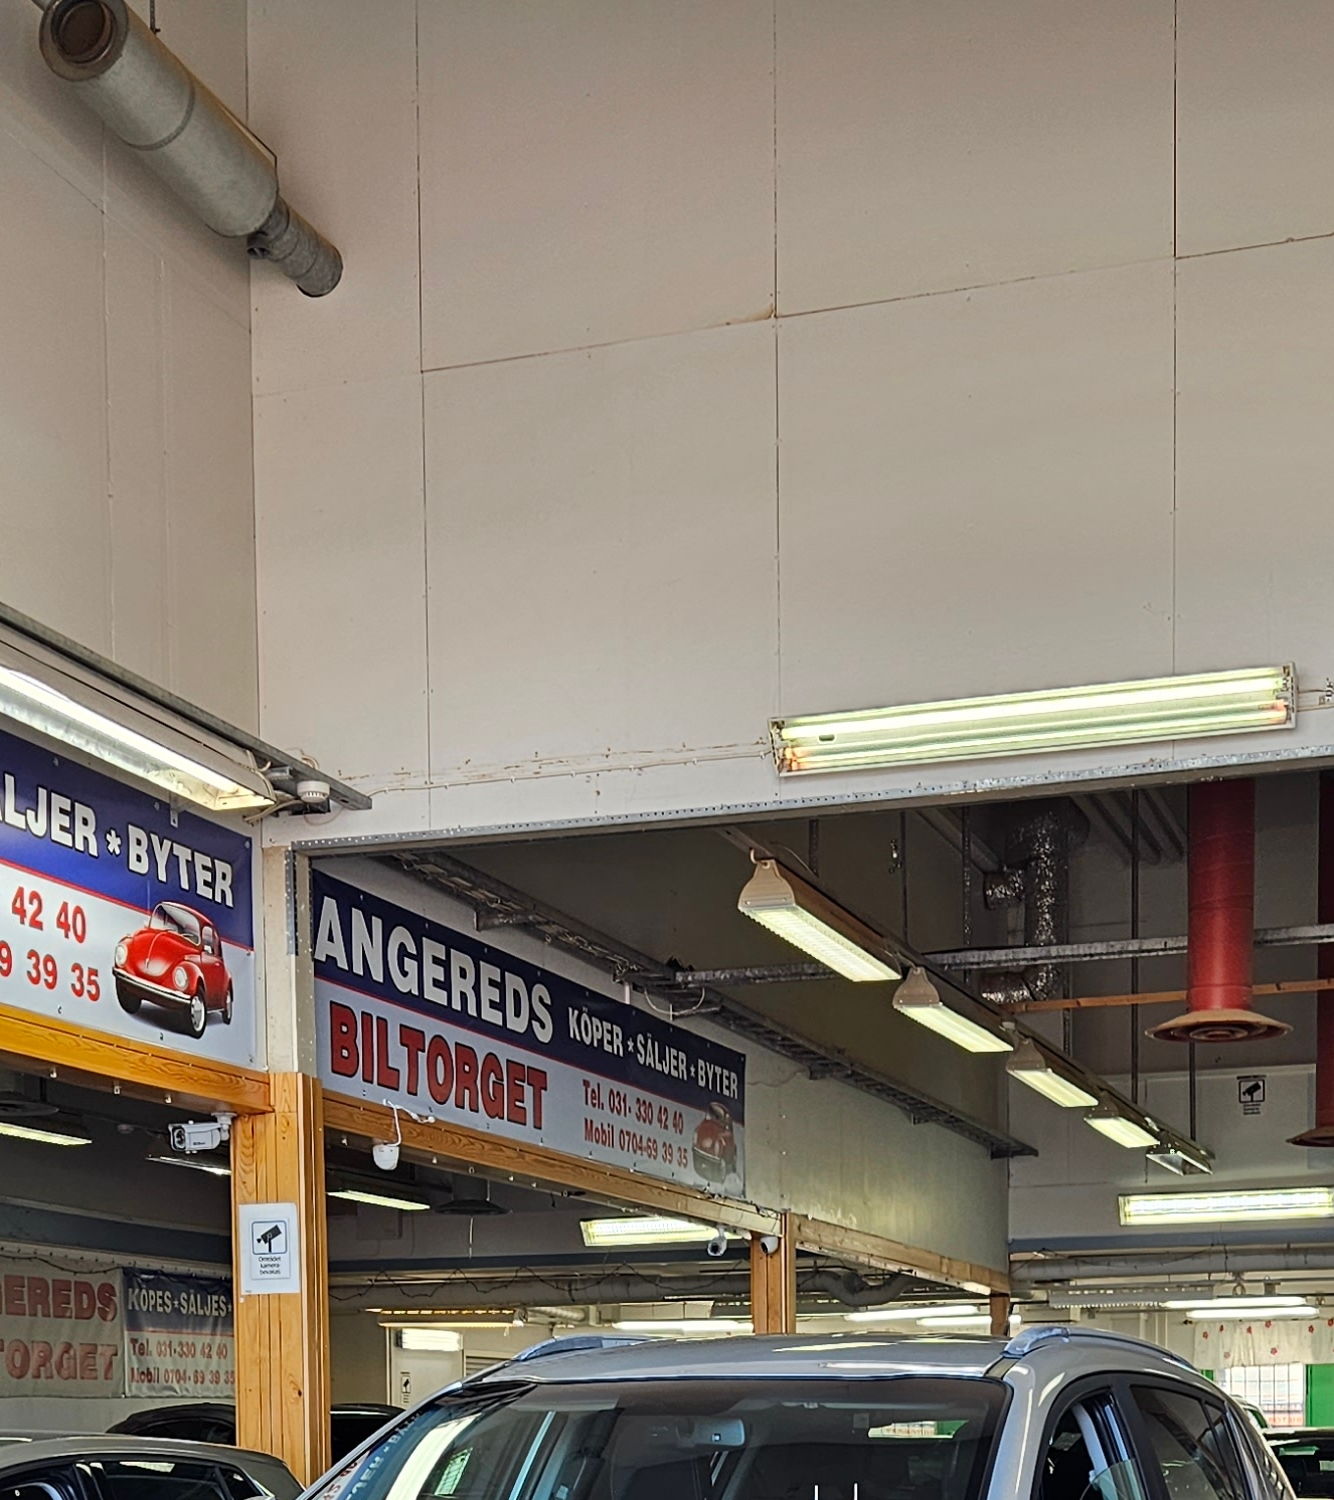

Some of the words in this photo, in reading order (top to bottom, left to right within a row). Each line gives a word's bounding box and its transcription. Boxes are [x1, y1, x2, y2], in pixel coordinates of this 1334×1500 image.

[127, 824, 234, 908] BYTER
[11, 886, 44, 931] 42
[56, 901, 86, 943] 40
[26, 949, 57, 990] 39
[70, 962, 100, 1001] 35
[314, 895, 554, 1044] ANGEREDS
[330, 1000, 548, 1130] BILTORGET
[568, 1006, 624, 1058] KÖPER
[637, 1031, 688, 1081] SÄLJER
[697, 1058, 738, 1100] BYTER
[582, 1079, 605, 1111] Tel.
[635, 1097, 654, 1125] 330
[657, 1105, 669, 1131] 42
[672, 1111, 684, 1136] 40
[584, 1117, 615, 1149] Mobil
[619, 1129, 657, 1161] 0704-69
[662, 1140, 674, 1165] 39
[677, 1146, 688, 1169] 35
[128, 1283, 172, 1314] KÖPES
[180, 1289, 227, 1318] SÄLJES
[130, 1367, 160, 1385] Mobil
